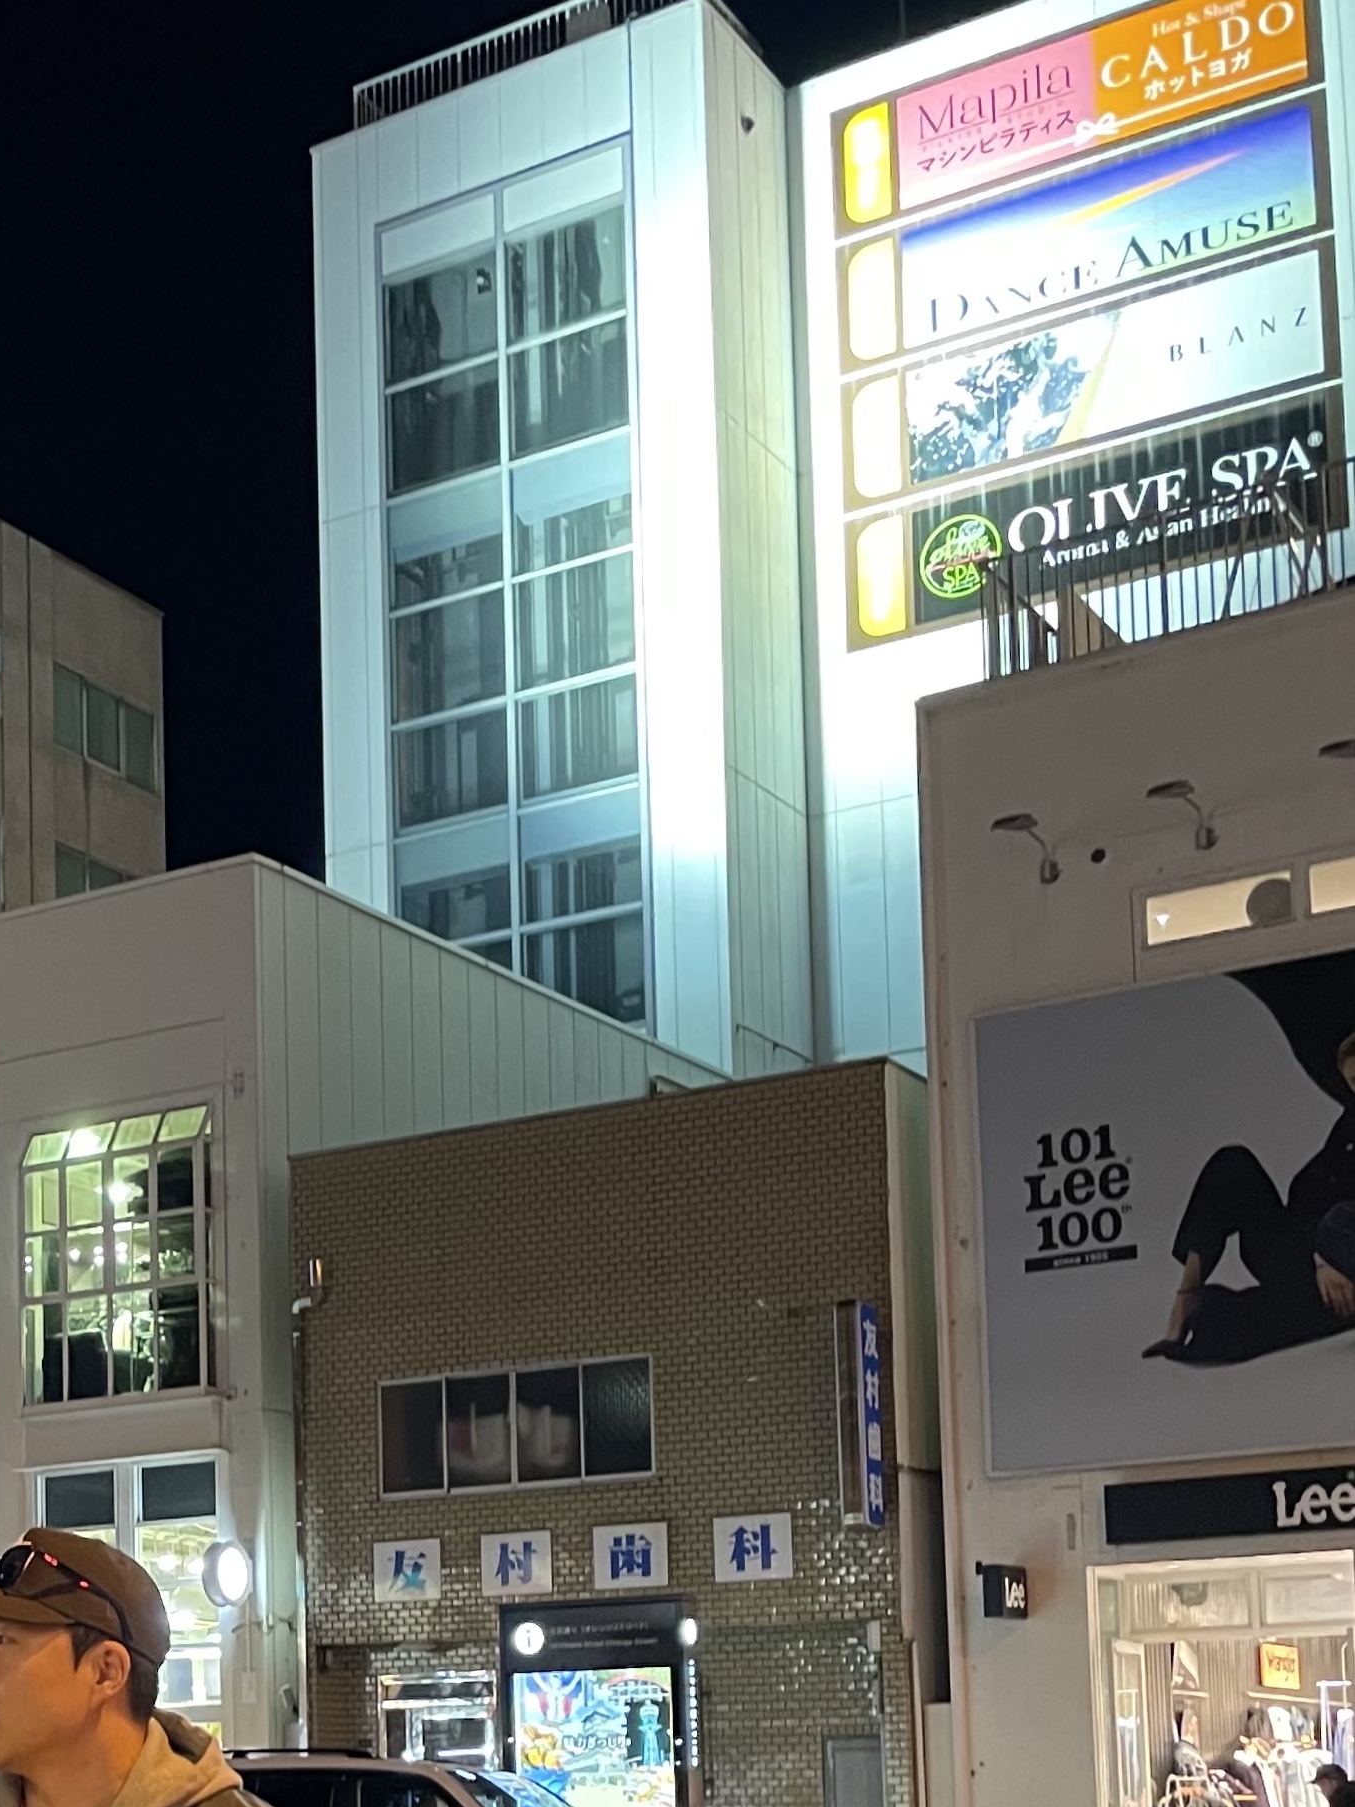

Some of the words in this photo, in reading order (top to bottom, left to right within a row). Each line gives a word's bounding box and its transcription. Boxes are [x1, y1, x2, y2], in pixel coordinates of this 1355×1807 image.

[1101, 1, 1294, 88] CALDO
[1144, 47, 1253, 100] ホットヨガ
[918, 63, 1075, 140] Mapila
[917, 109, 1075, 172] マシンピラティス
[1115, 199, 1295, 278] AMUSE
[1169, 305, 1308, 363] BLANZ
[1008, 467, 1191, 552] OLIVE
[1115, 529, 1130, 550] &
[942, 562, 981, 589] SPA
[1036, 1123, 1117, 1169] 101
[1024, 1162, 1131, 1213] Lee
[1272, 1481, 1355, 1528] Lee
[386, 1523, 778, 1593] 友村歯科
